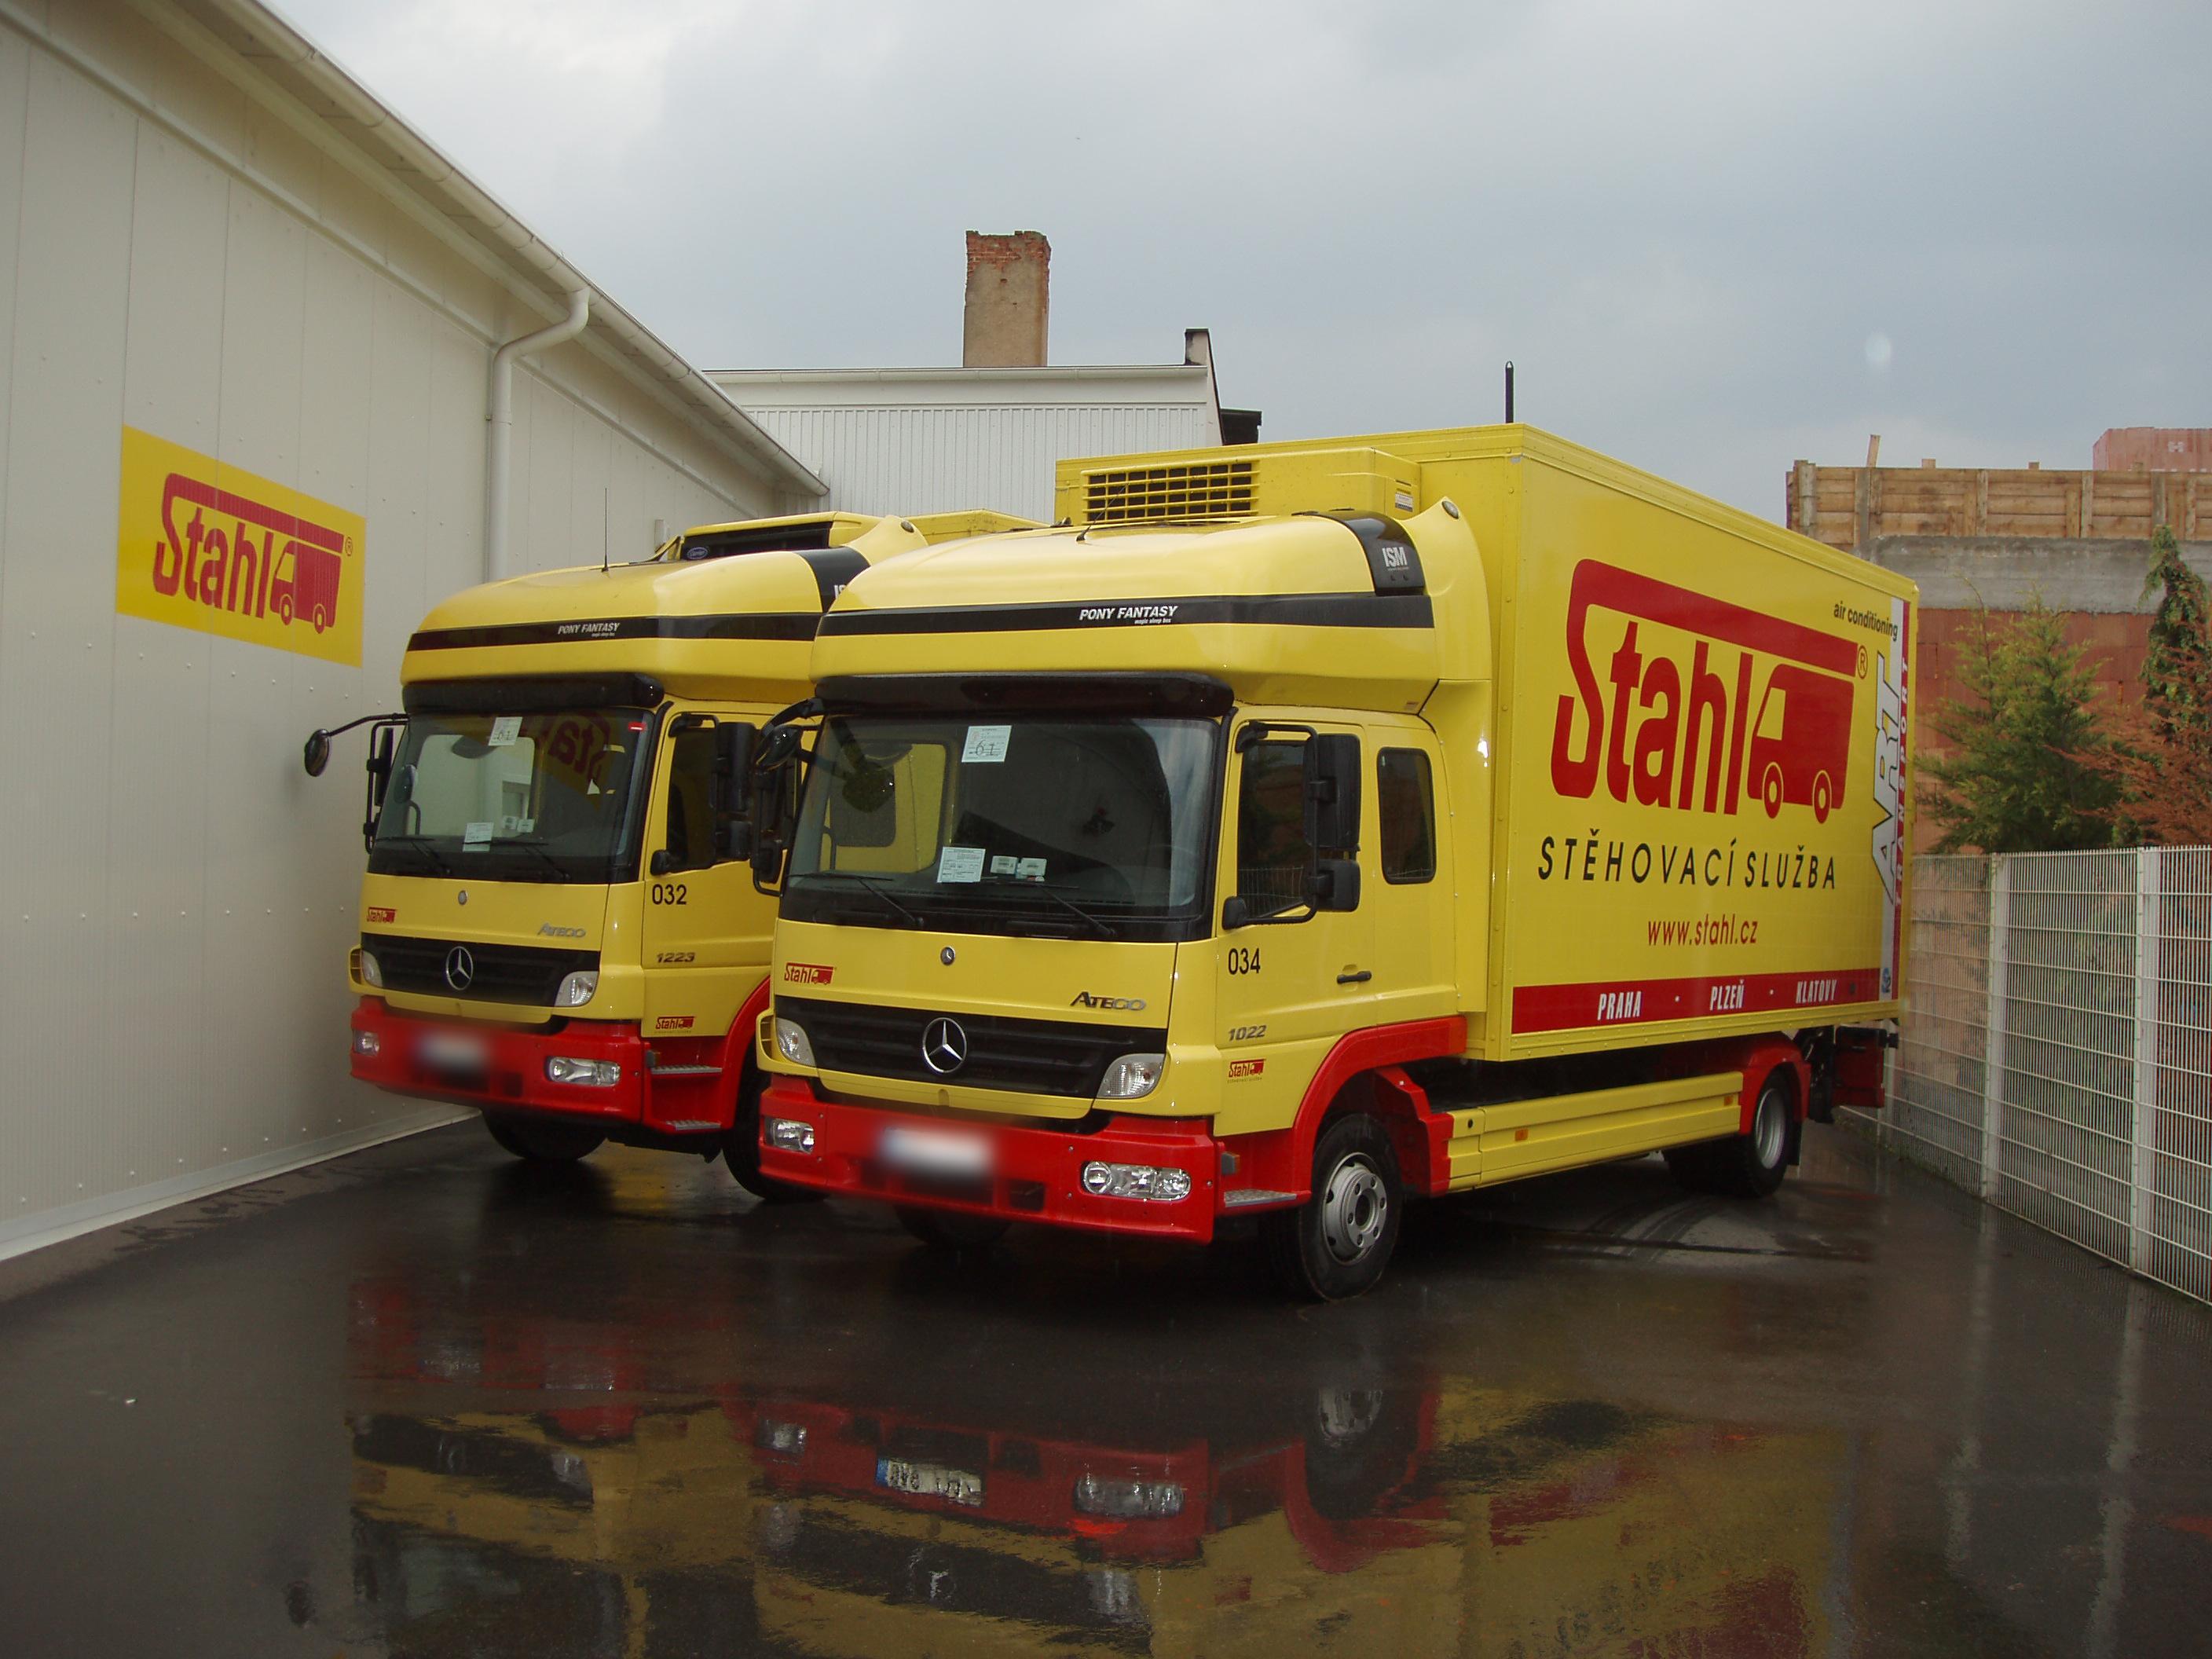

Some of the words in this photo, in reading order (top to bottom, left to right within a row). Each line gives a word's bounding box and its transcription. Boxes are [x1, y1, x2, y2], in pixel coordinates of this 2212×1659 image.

[152, 473, 275, 619] Stahl
[1382, 546, 1408, 567] ISM
[557, 624, 581, 635] PONY
[580, 622, 621, 633] FANTASY
[1079, 608, 1116, 621] PONY
[1116, 605, 1178, 619] FANTASY
[1833, 600, 1846, 620] air
[1847, 610, 1899, 642] conditioning
[1551, 558, 1754, 815] Stahl
[1895, 657, 1909, 905] TRANSPORT
[1537, 828, 1738, 888] STĚHOVACÍ
[1744, 844, 1836, 889] SLUŽBA
[652, 884, 688, 906] 032
[1647, 913, 1759, 947] www.stahl.cz
[657, 952, 696, 964] 1223
[1228, 947, 1262, 976] 034
[1597, 991, 1643, 1021] PRAHA
[1708, 979, 1745, 1012] PLZEŇ
[1795, 980, 1838, 1005] KLATOVY
[1228, 1024, 1267, 1042] 1022
